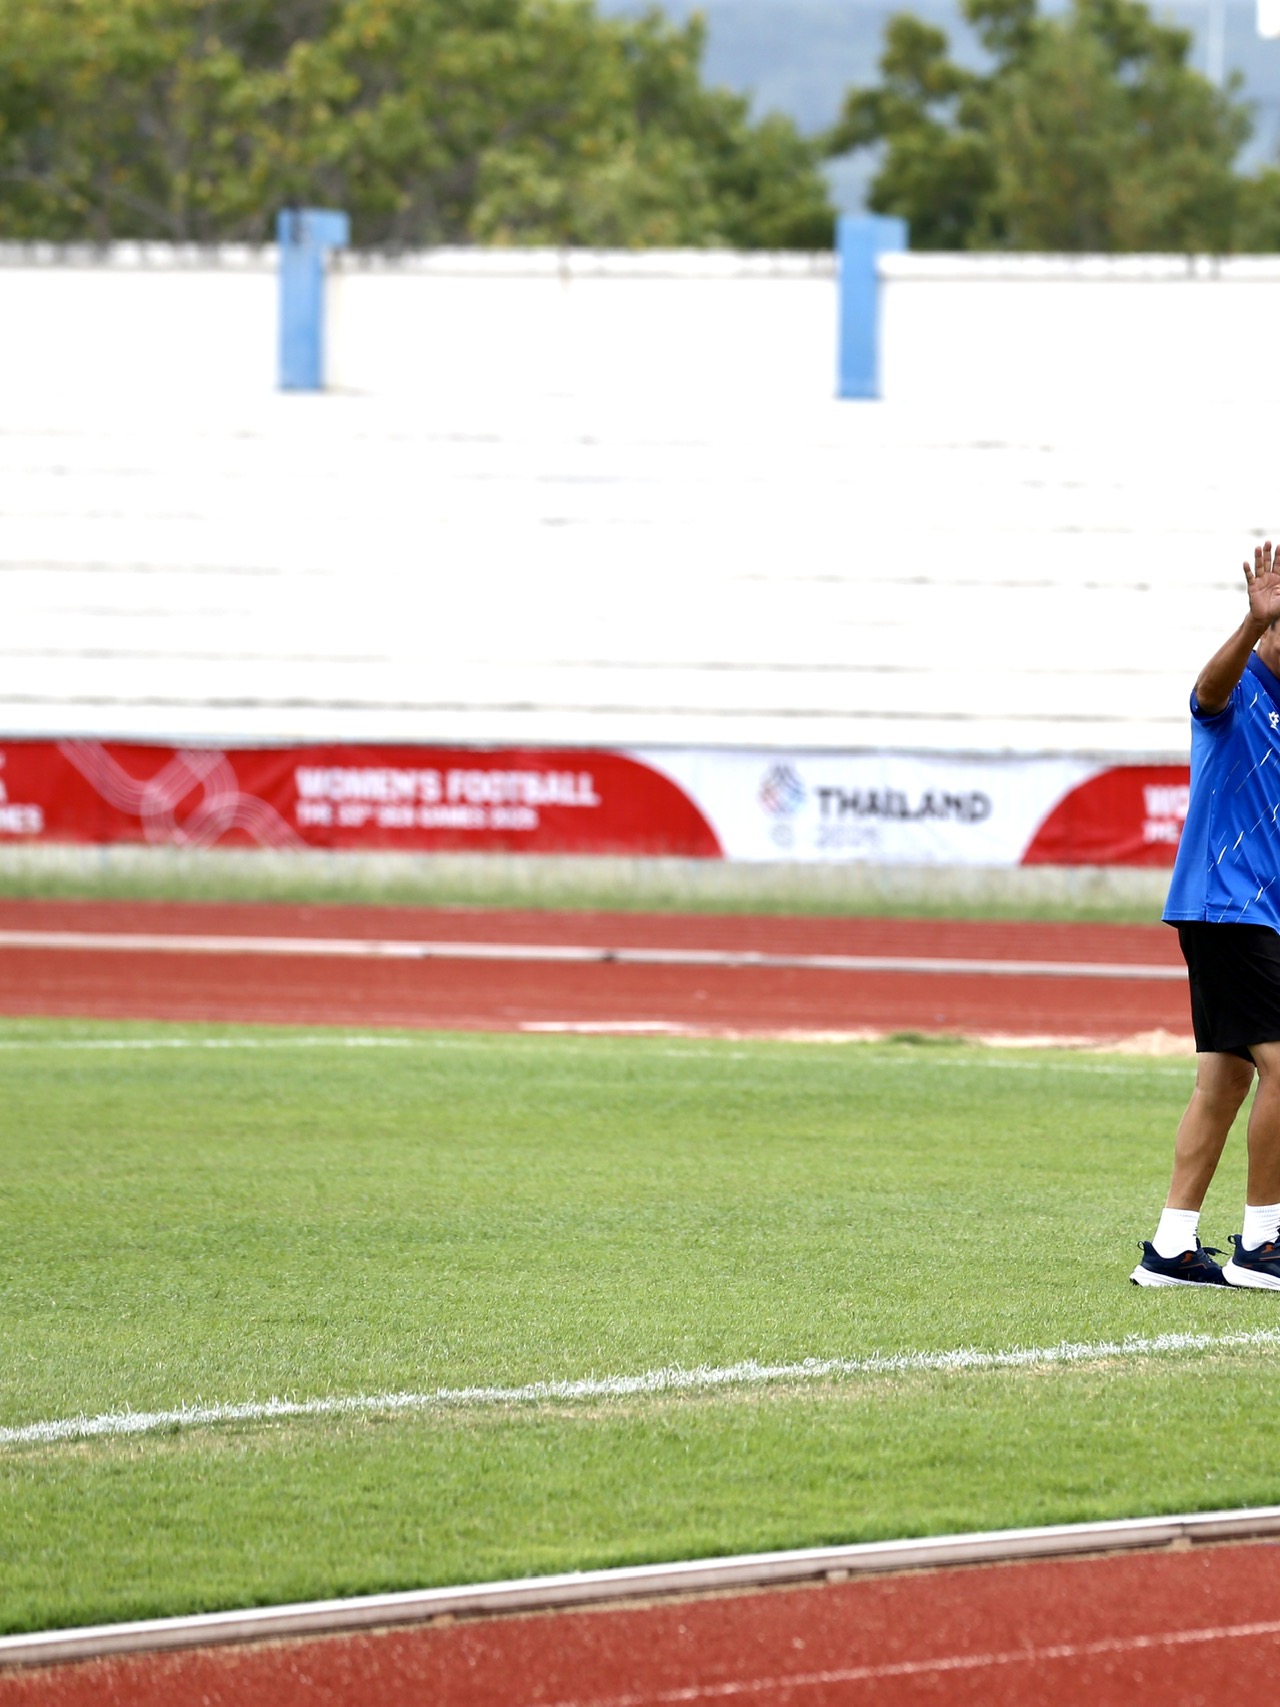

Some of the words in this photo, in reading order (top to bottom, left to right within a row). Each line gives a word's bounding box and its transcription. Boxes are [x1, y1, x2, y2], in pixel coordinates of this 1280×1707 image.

[296, 767, 441, 802] WOMEN'S
[446, 769, 600, 806] FOOTBALL
[816, 786, 992, 824] THAILAND
[0, 804, 43, 833] MES
